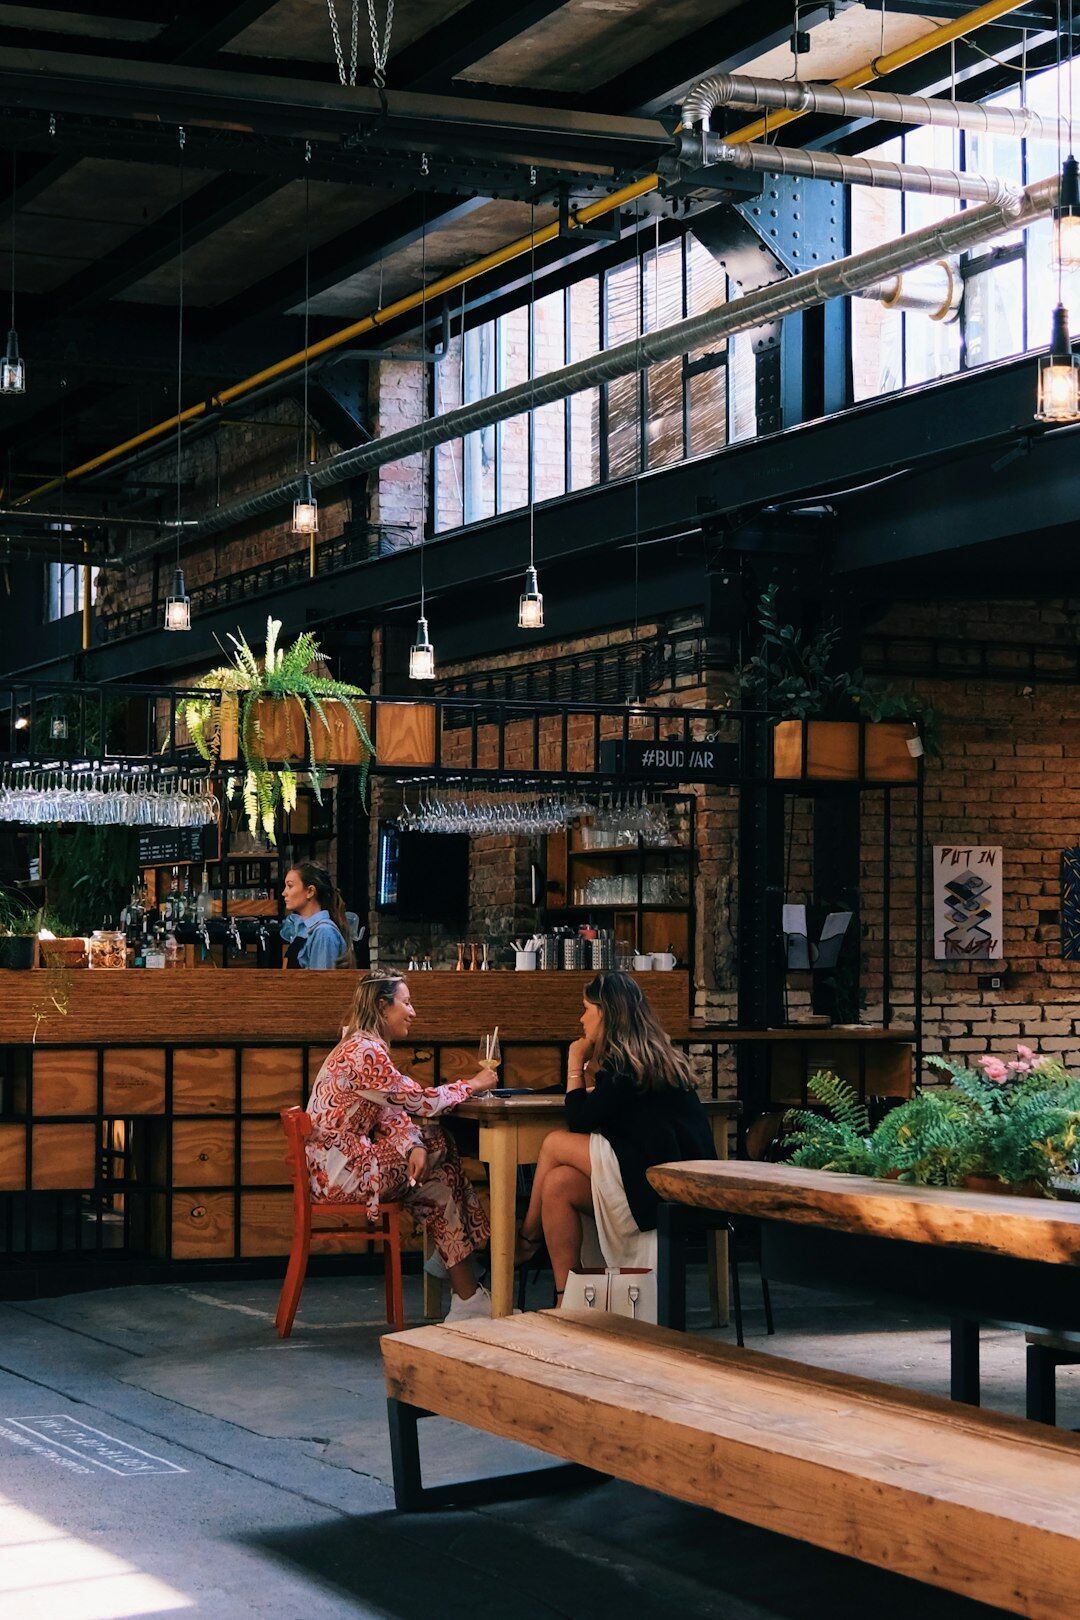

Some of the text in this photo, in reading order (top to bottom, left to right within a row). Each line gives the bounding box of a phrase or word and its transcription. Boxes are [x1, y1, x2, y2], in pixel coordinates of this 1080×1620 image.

[940, 848, 997, 867] PUT IN
[938, 937, 998, 954] TRASH
